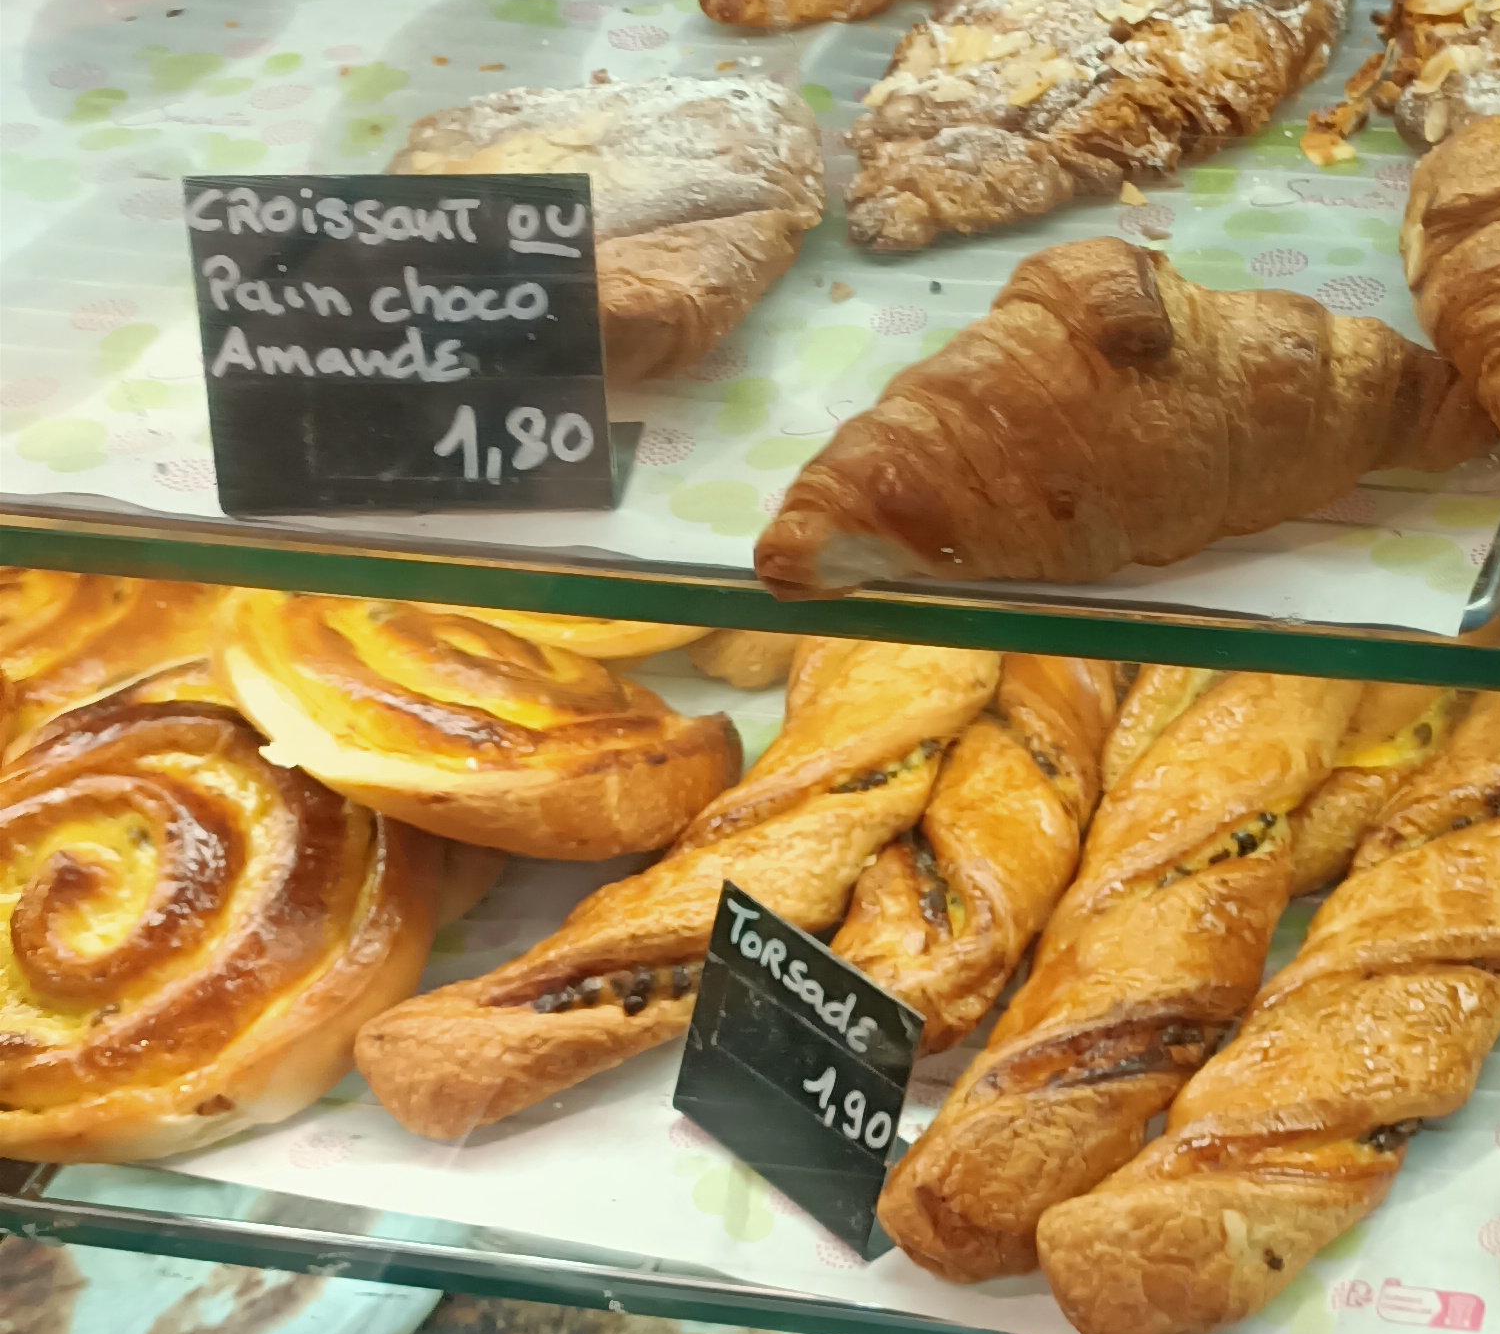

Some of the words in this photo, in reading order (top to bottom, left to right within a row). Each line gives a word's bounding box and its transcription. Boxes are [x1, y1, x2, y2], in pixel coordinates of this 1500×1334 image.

[203, 255, 353, 316] Pain
[370, 266, 549, 323] choco
[434, 405, 595, 485] 1,80
[803, 1067, 892, 1149] 1,90
